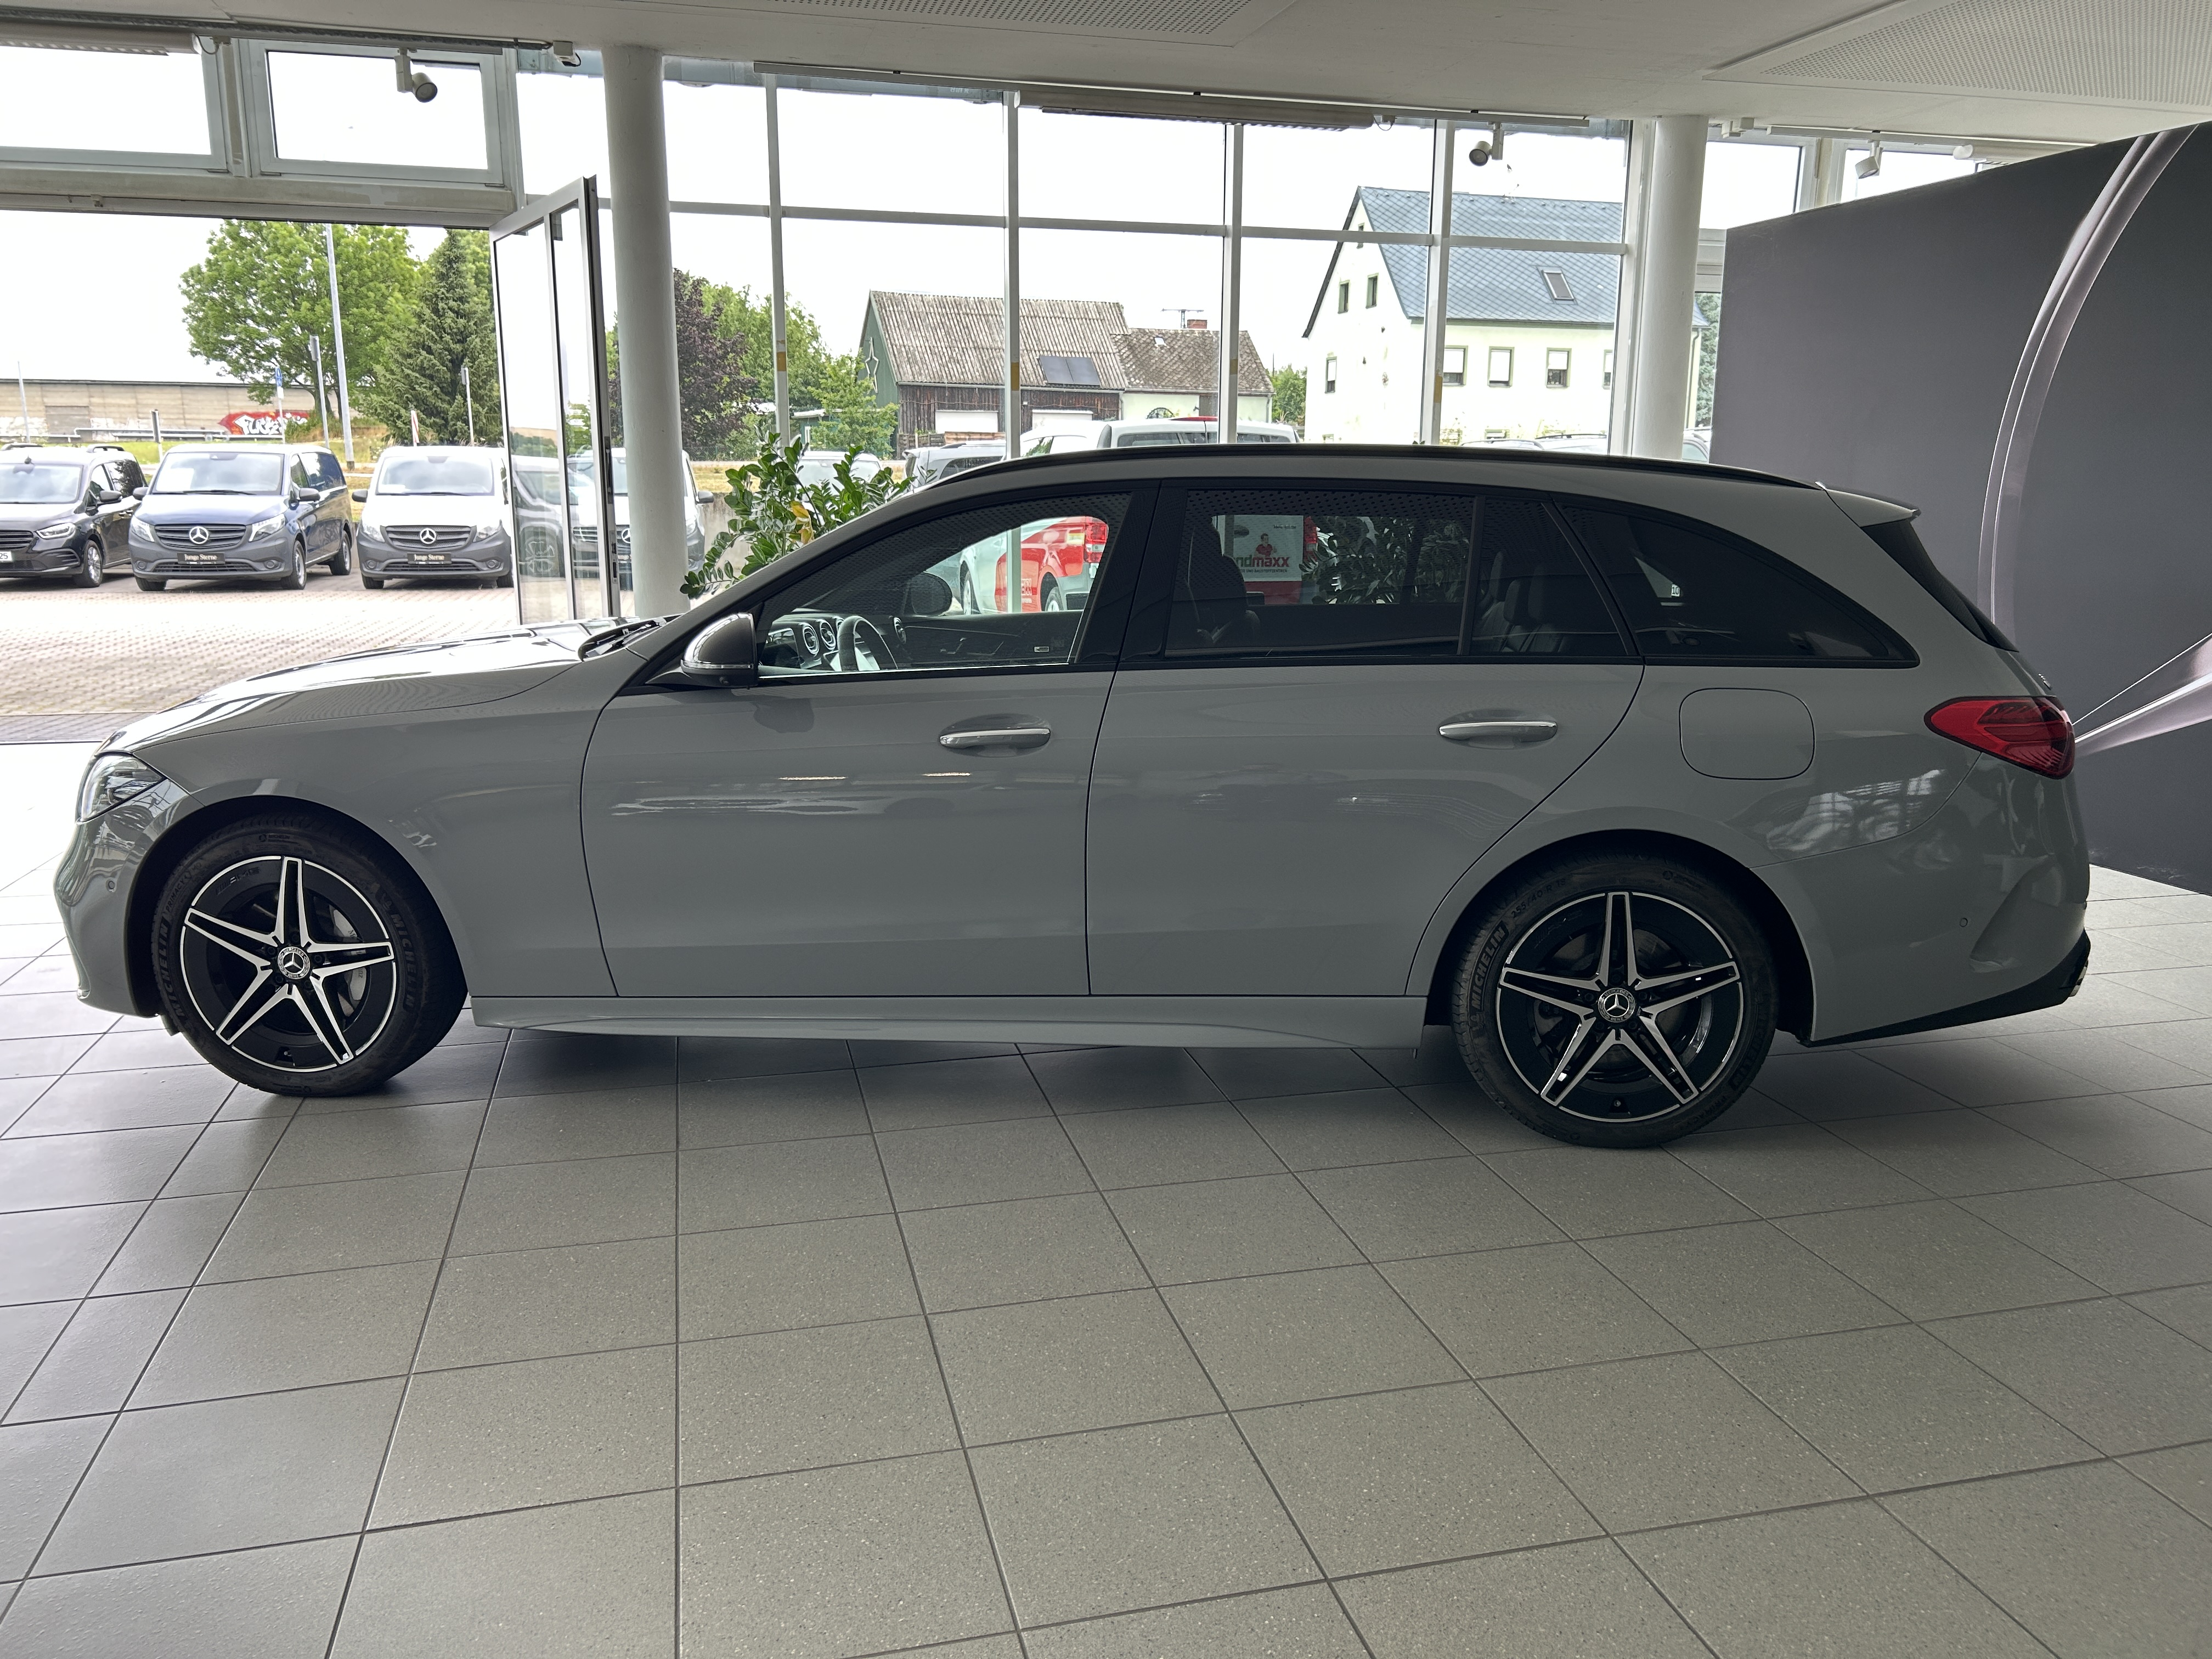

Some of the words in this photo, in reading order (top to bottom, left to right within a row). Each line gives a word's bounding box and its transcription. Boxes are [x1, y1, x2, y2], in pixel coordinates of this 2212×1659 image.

[1234, 555, 1290, 567] ndmaxx
[159, 923, 185, 1017] MICHELIN
[391, 913, 417, 1007] MICHELIN
[1471, 927, 1505, 1009] MICHELIN
